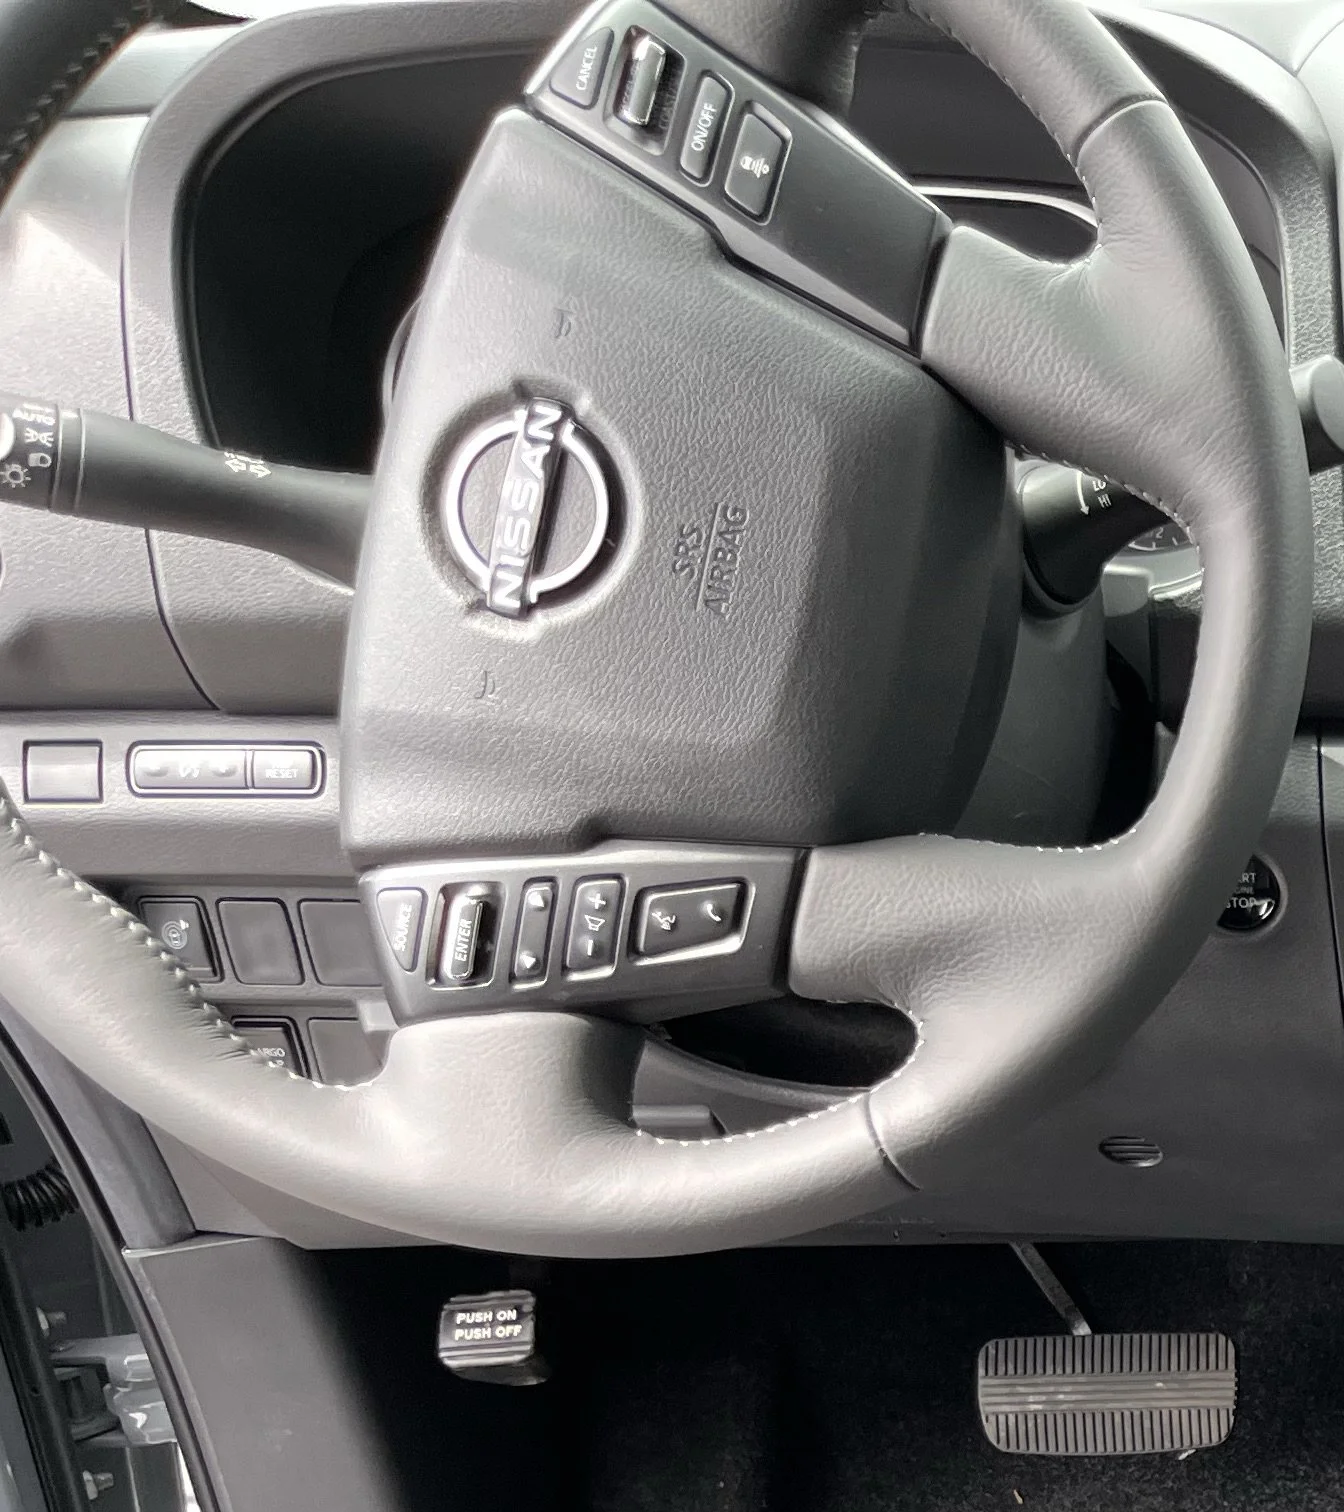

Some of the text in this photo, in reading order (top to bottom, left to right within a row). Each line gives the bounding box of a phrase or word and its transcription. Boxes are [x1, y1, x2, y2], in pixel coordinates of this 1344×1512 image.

[576, 45, 598, 92] CANCEL
[690, 102, 719, 152] ON/OFF
[490, 403, 562, 609] NISSAN
[671, 517, 706, 579] SRS
[703, 504, 750, 620] AIRBAG
[393, 904, 413, 952] SOURCE
[455, 919, 472, 962] ENTER
[454, 1324, 522, 1340] PUSH OFF
[456, 1309, 517, 1324] PUSH ON
